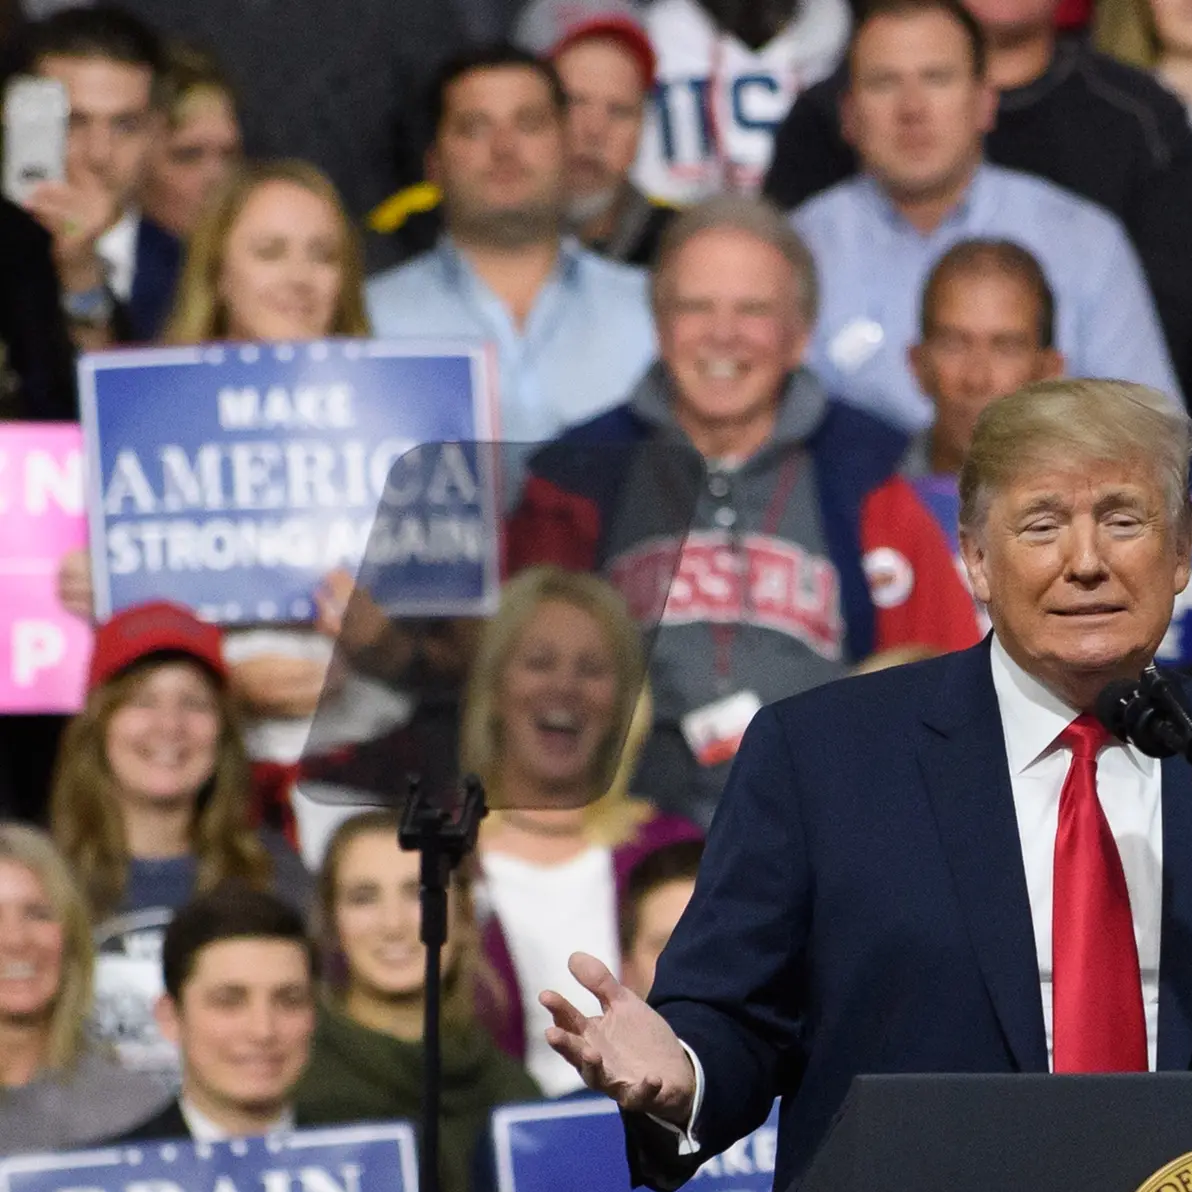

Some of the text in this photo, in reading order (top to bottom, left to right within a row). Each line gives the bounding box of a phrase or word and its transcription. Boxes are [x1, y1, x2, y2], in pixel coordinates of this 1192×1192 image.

[217, 384, 353, 430] MAKE
[103, 440, 477, 514] AMERICA
[106, 517, 315, 575] STRONG
